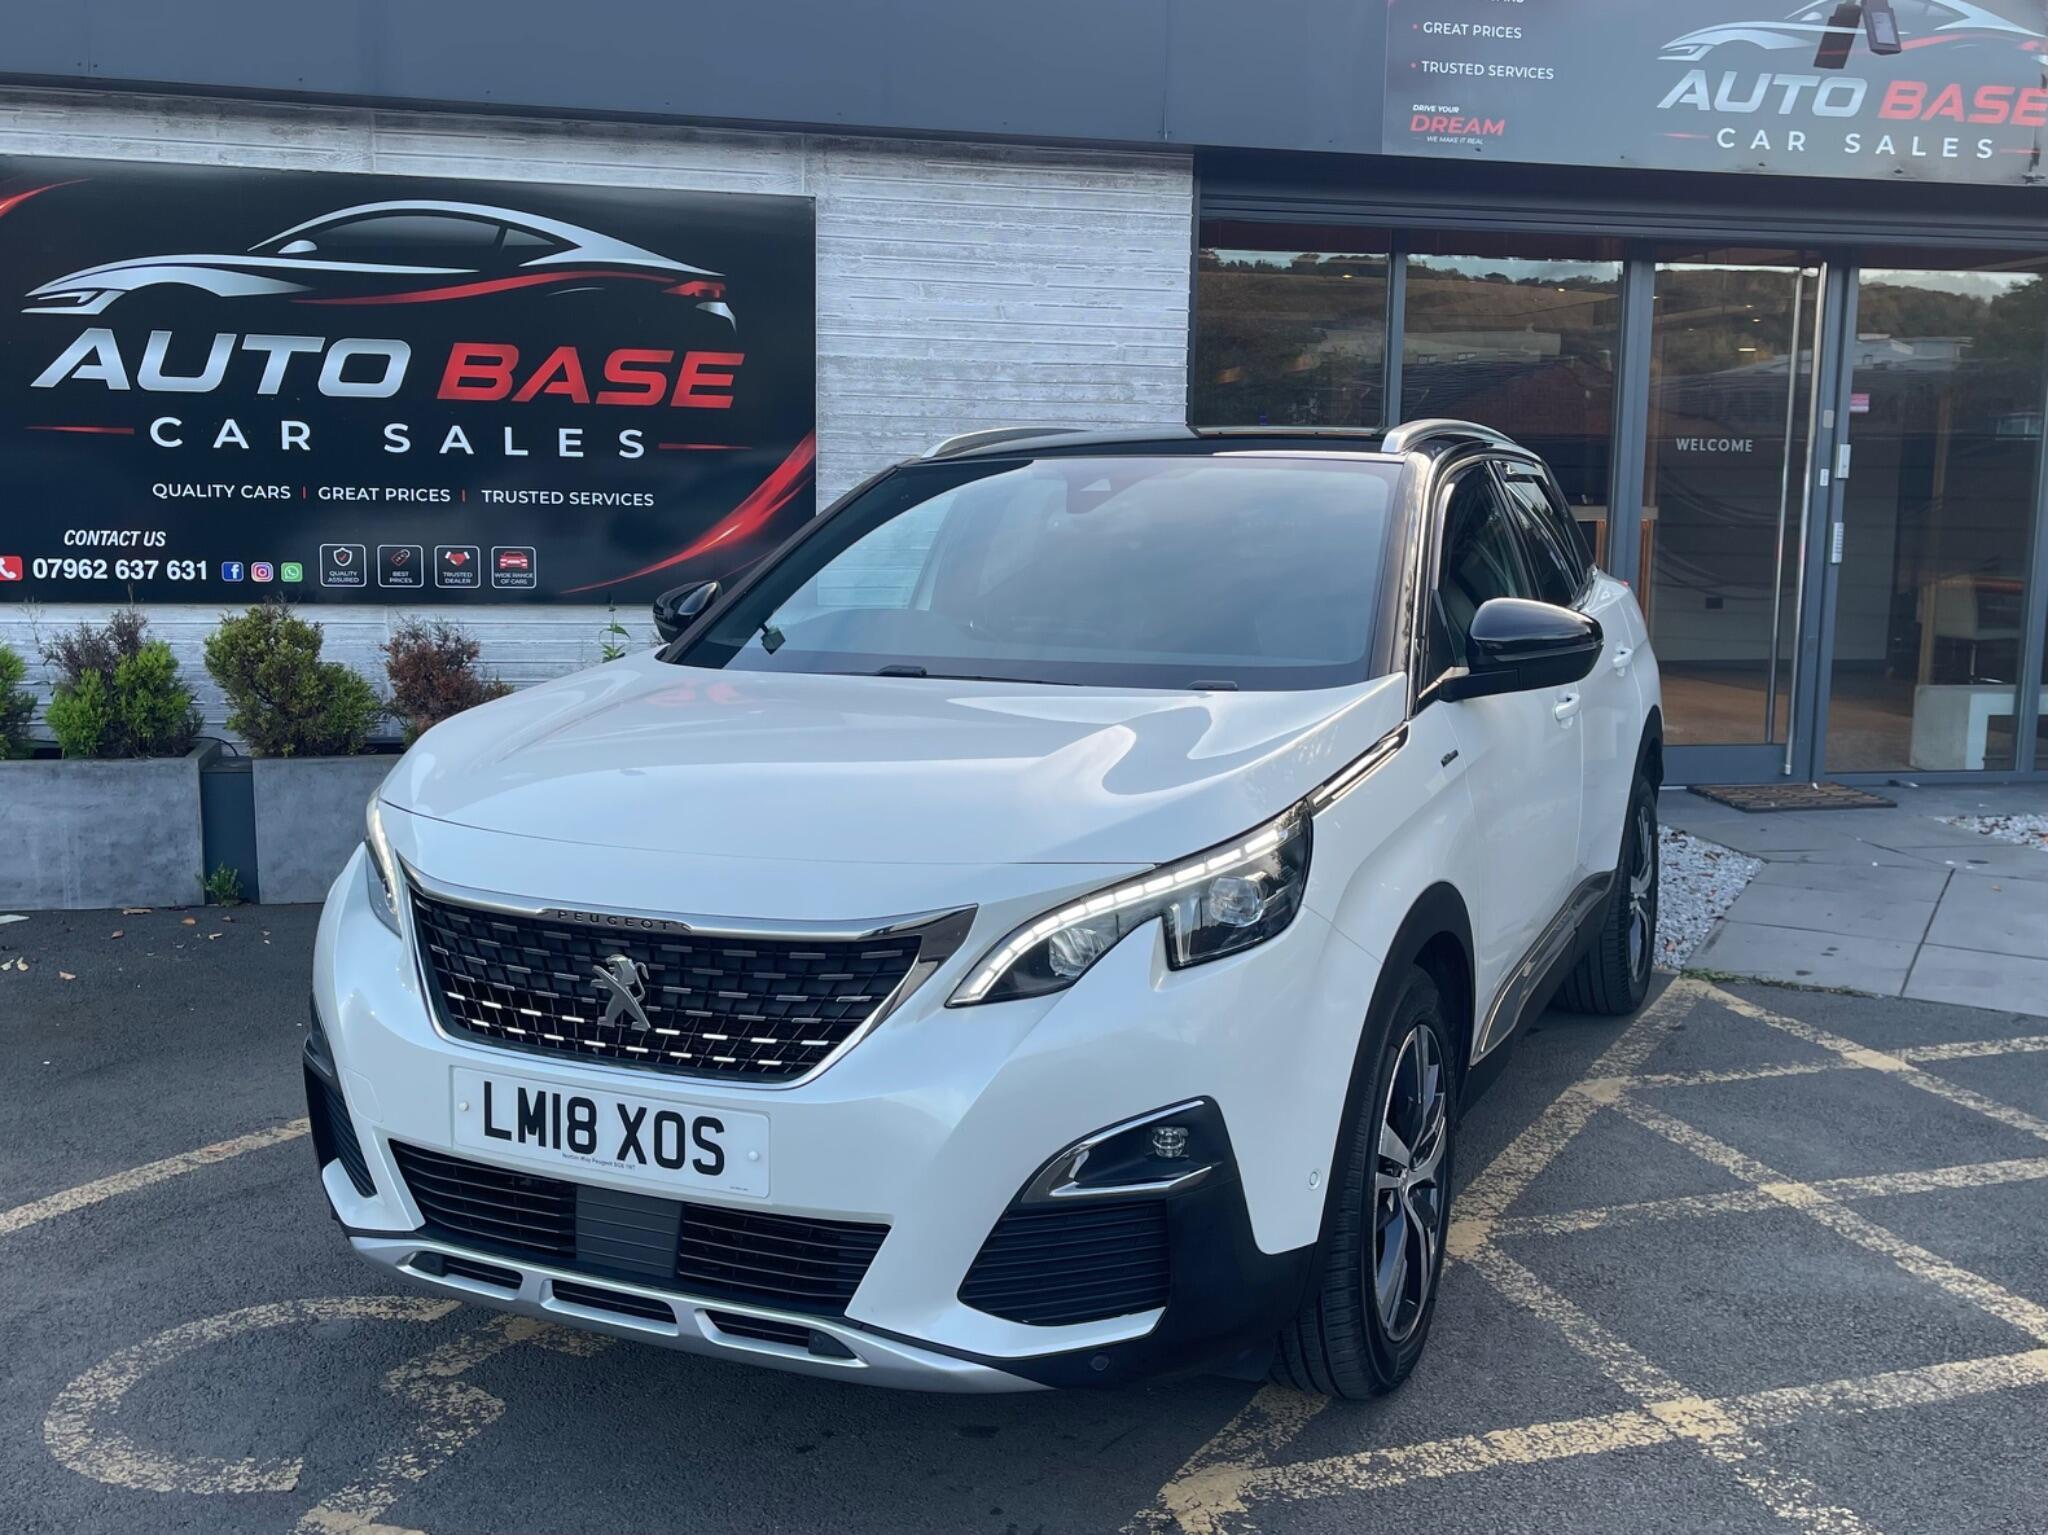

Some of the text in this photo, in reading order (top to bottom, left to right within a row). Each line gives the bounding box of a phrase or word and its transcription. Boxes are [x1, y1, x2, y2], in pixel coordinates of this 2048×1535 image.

[1423, 22, 1522, 39] GREAT PRICES
[1421, 60, 1554, 80] TRUSTED SERVICES
[1657, 69, 2048, 127] AUTO BASE
[1412, 104, 1460, 113] DRIVE YOUR
[1409, 114, 1505, 136] DREAM
[1439, 136, 1458, 144] MAKE
[1716, 127, 1993, 159] CAR SALES
[30, 327, 745, 410] AUTO BASE
[149, 416, 646, 459] CAR SALES
[1676, 437, 1753, 453] WELCOME
[152, 483, 291, 499] QUALITY CARS
[318, 486, 450, 503] GREAT PRICES
[481, 489, 655, 507] TRUSTED SERVICES
[64, 529, 167, 547] CONTACT US
[32, 557, 207, 581] 07962 637 631
[329, 570, 358, 578] QUALITY
[557, 910, 673, 930] PEUGEOT
[483, 1081, 725, 1176] LM18 XOS
